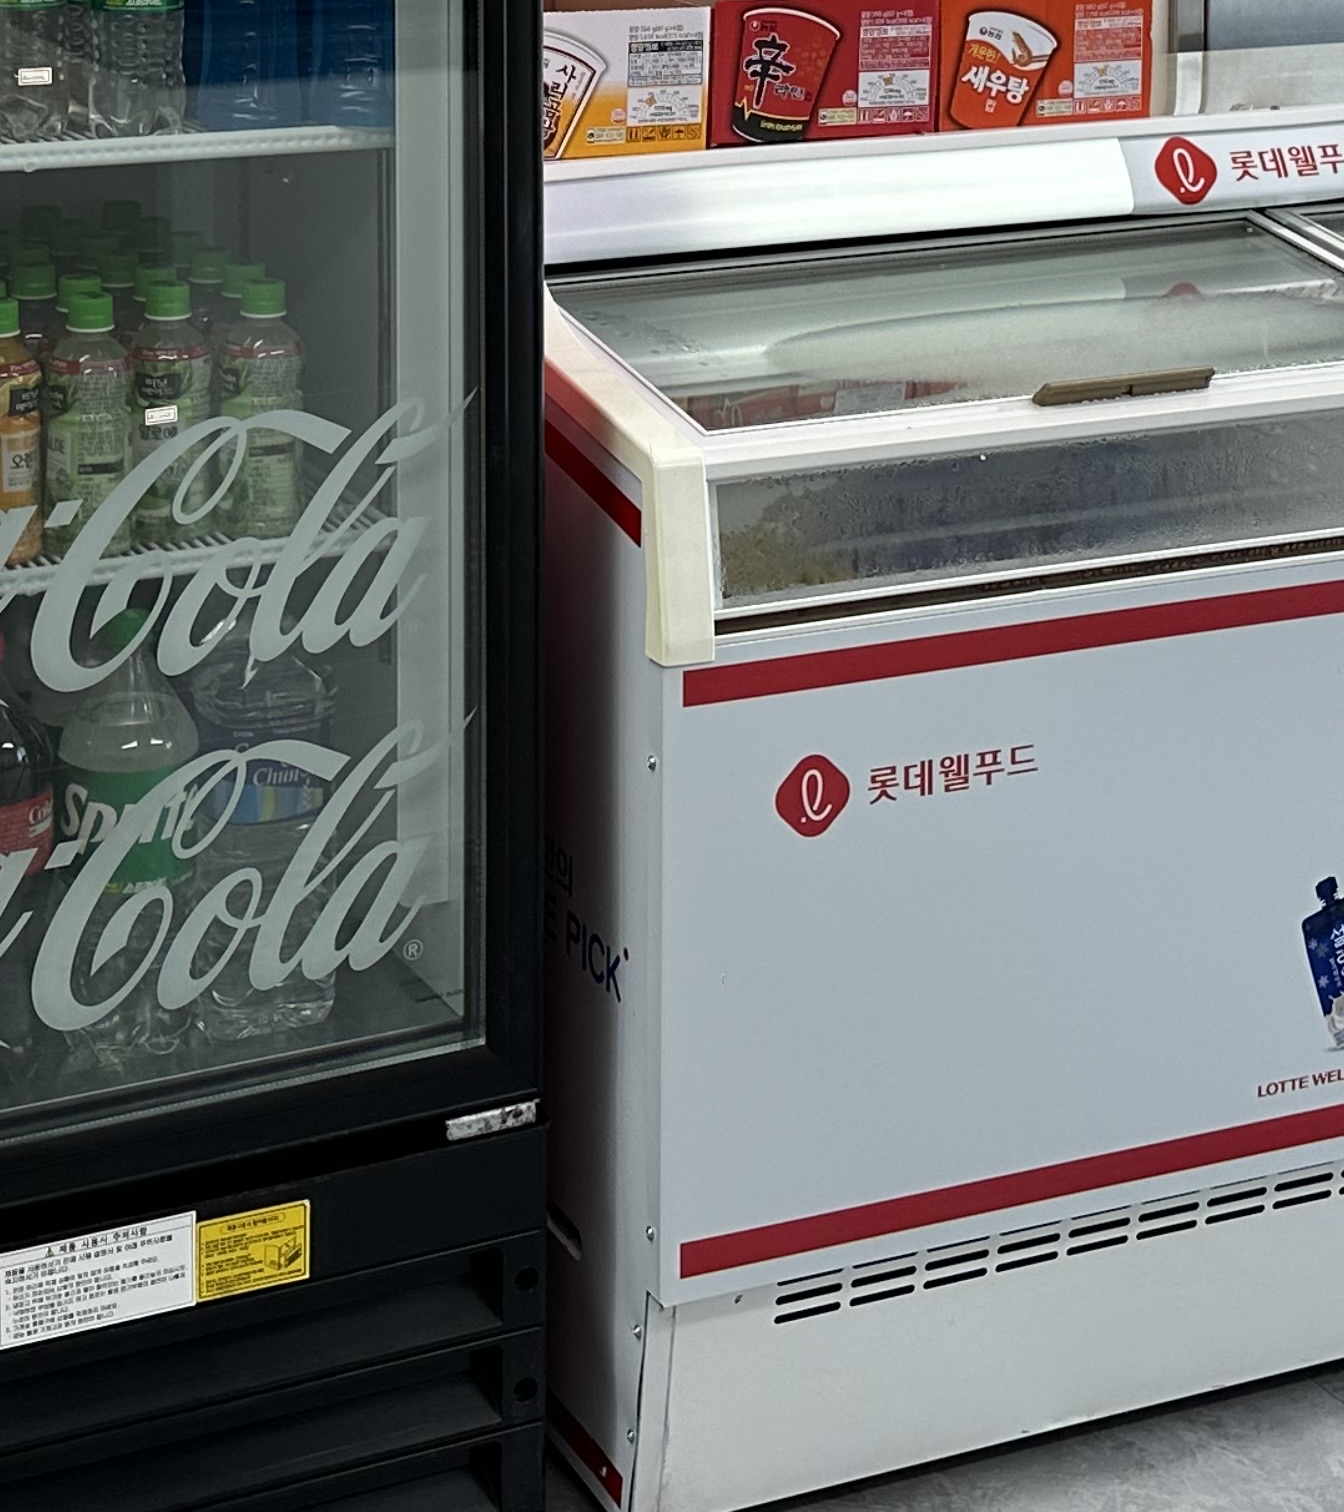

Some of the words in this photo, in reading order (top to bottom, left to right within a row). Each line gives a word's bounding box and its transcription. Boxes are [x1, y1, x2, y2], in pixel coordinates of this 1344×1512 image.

[742, 34, 797, 110] 辛
[961, 65, 1030, 105] 새우탕
[867, 744, 1039, 805] 롯데웰푸드
[566, 909, 622, 1003] PICK
[1257, 1075, 1309, 1098] LOTTE
